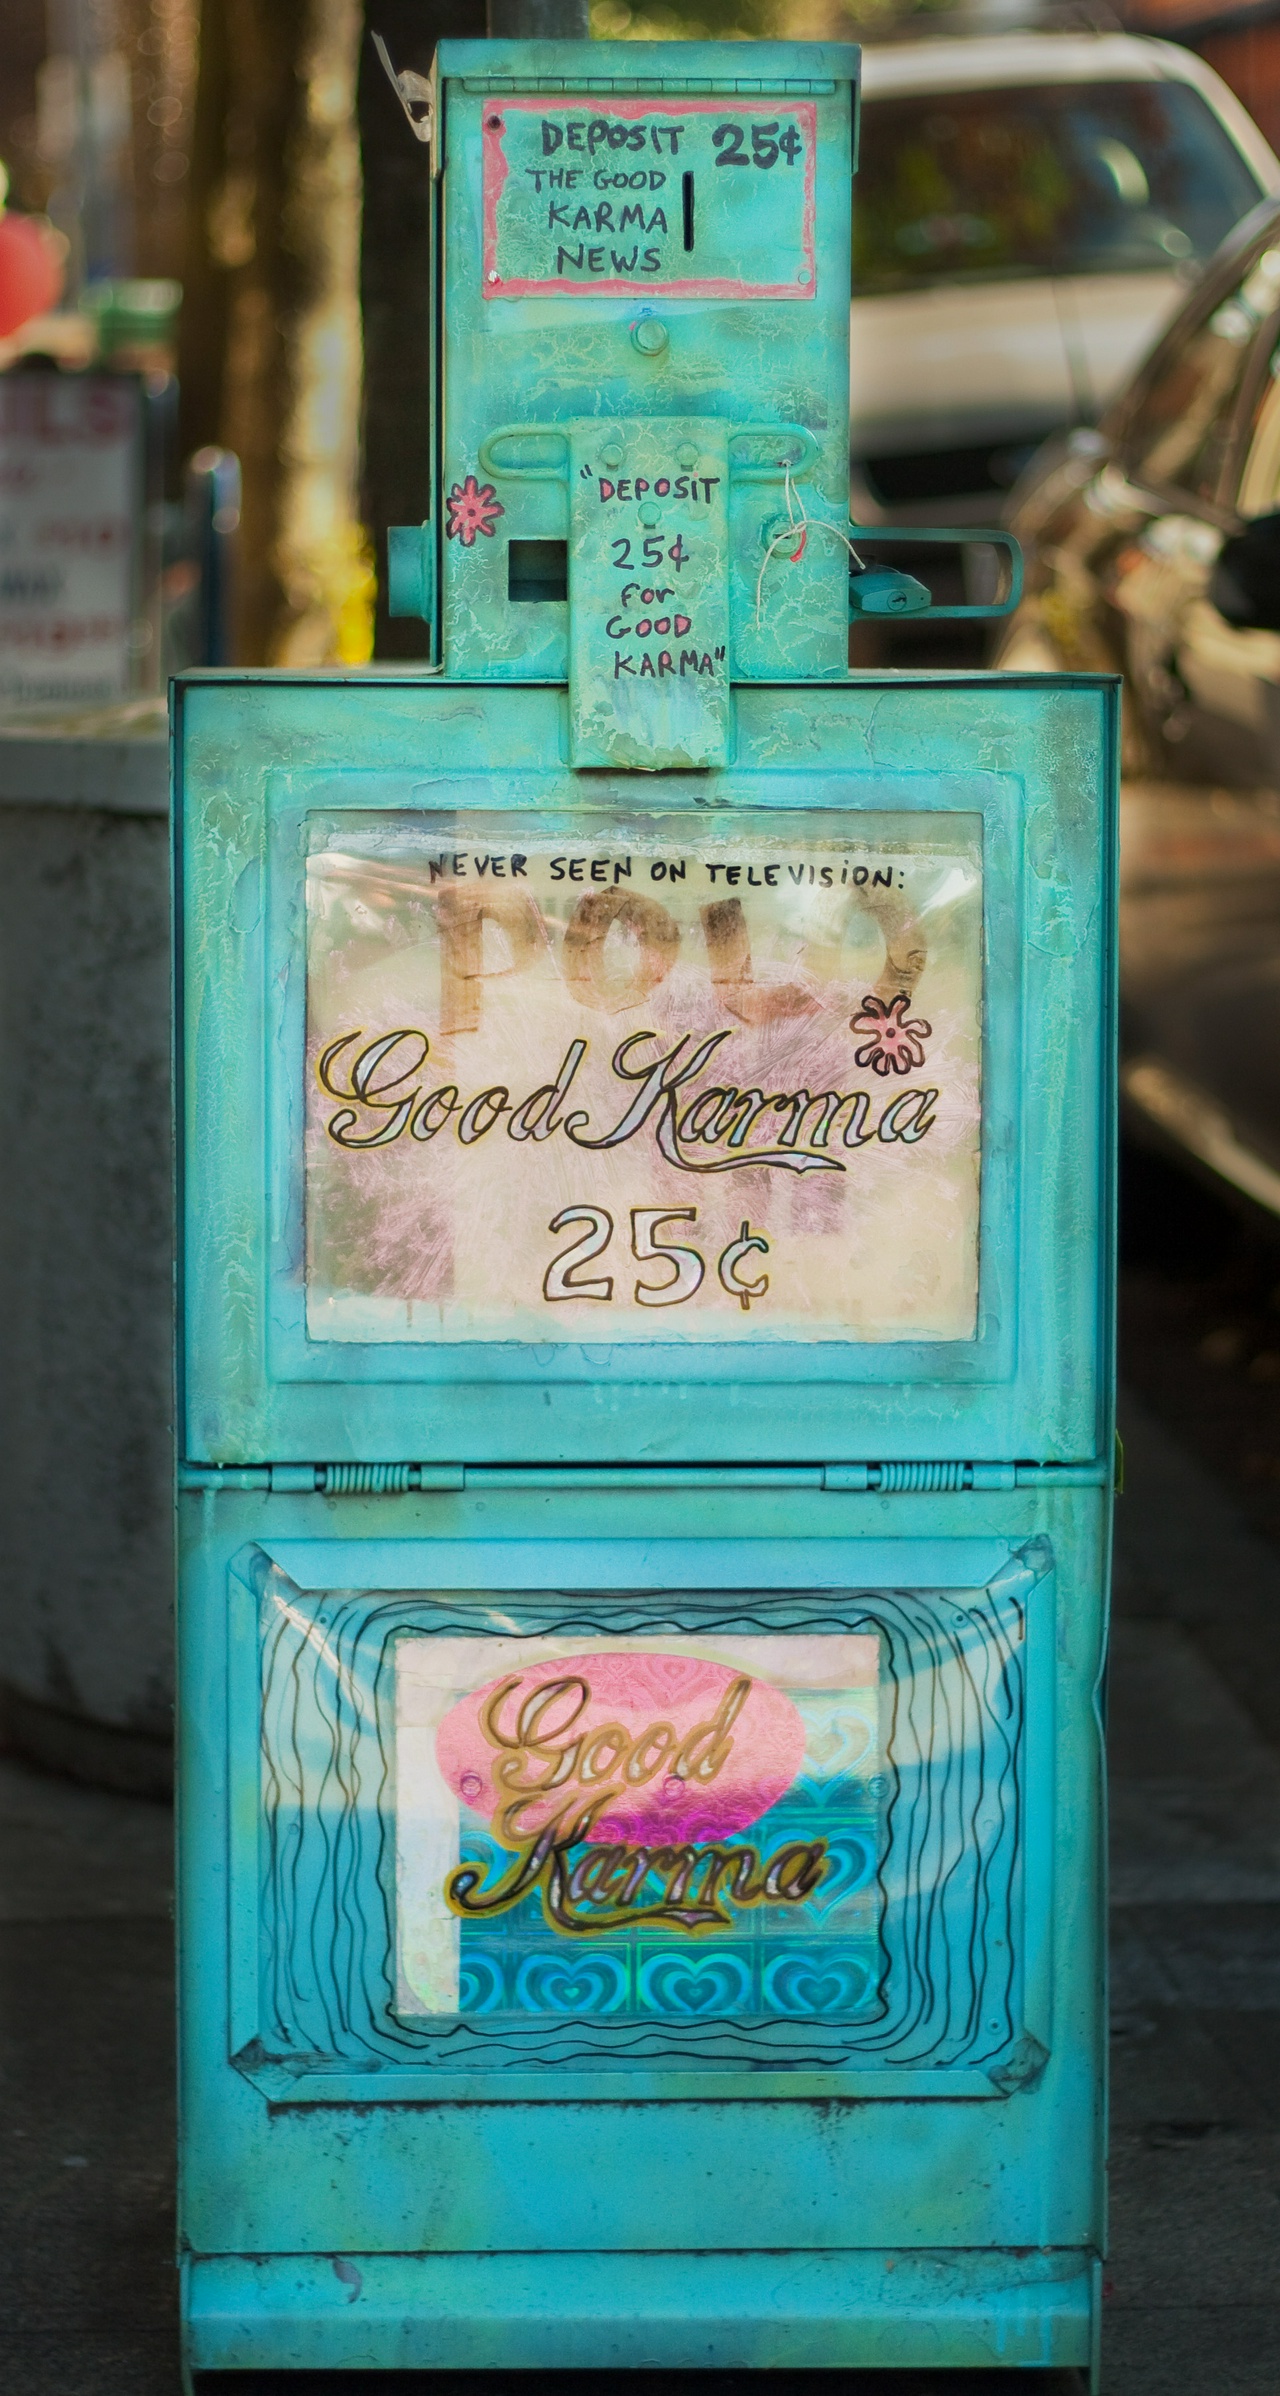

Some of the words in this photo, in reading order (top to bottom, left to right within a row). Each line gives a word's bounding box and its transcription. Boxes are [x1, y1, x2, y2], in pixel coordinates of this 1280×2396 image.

[541, 119, 685, 156] DEPOSIT
[712, 122, 802, 169] 25¢
[525, 168, 583, 194] THE
[594, 170, 667, 191] GOOD
[548, 201, 669, 234] KARMA
[557, 244, 662, 275] NEWS
[611, 534, 690, 573] 25¢
[605, 614, 693, 639] GOOD
[428, 853, 528, 885] NEVER
[549, 856, 632, 884] SEEN
[650, 859, 687, 882] ON
[319, 1028, 588, 1149] Good
[563, 1028, 939, 1174] Karma
[479, 1675, 752, 1793] Good
[445, 1784, 829, 1937] Karma
